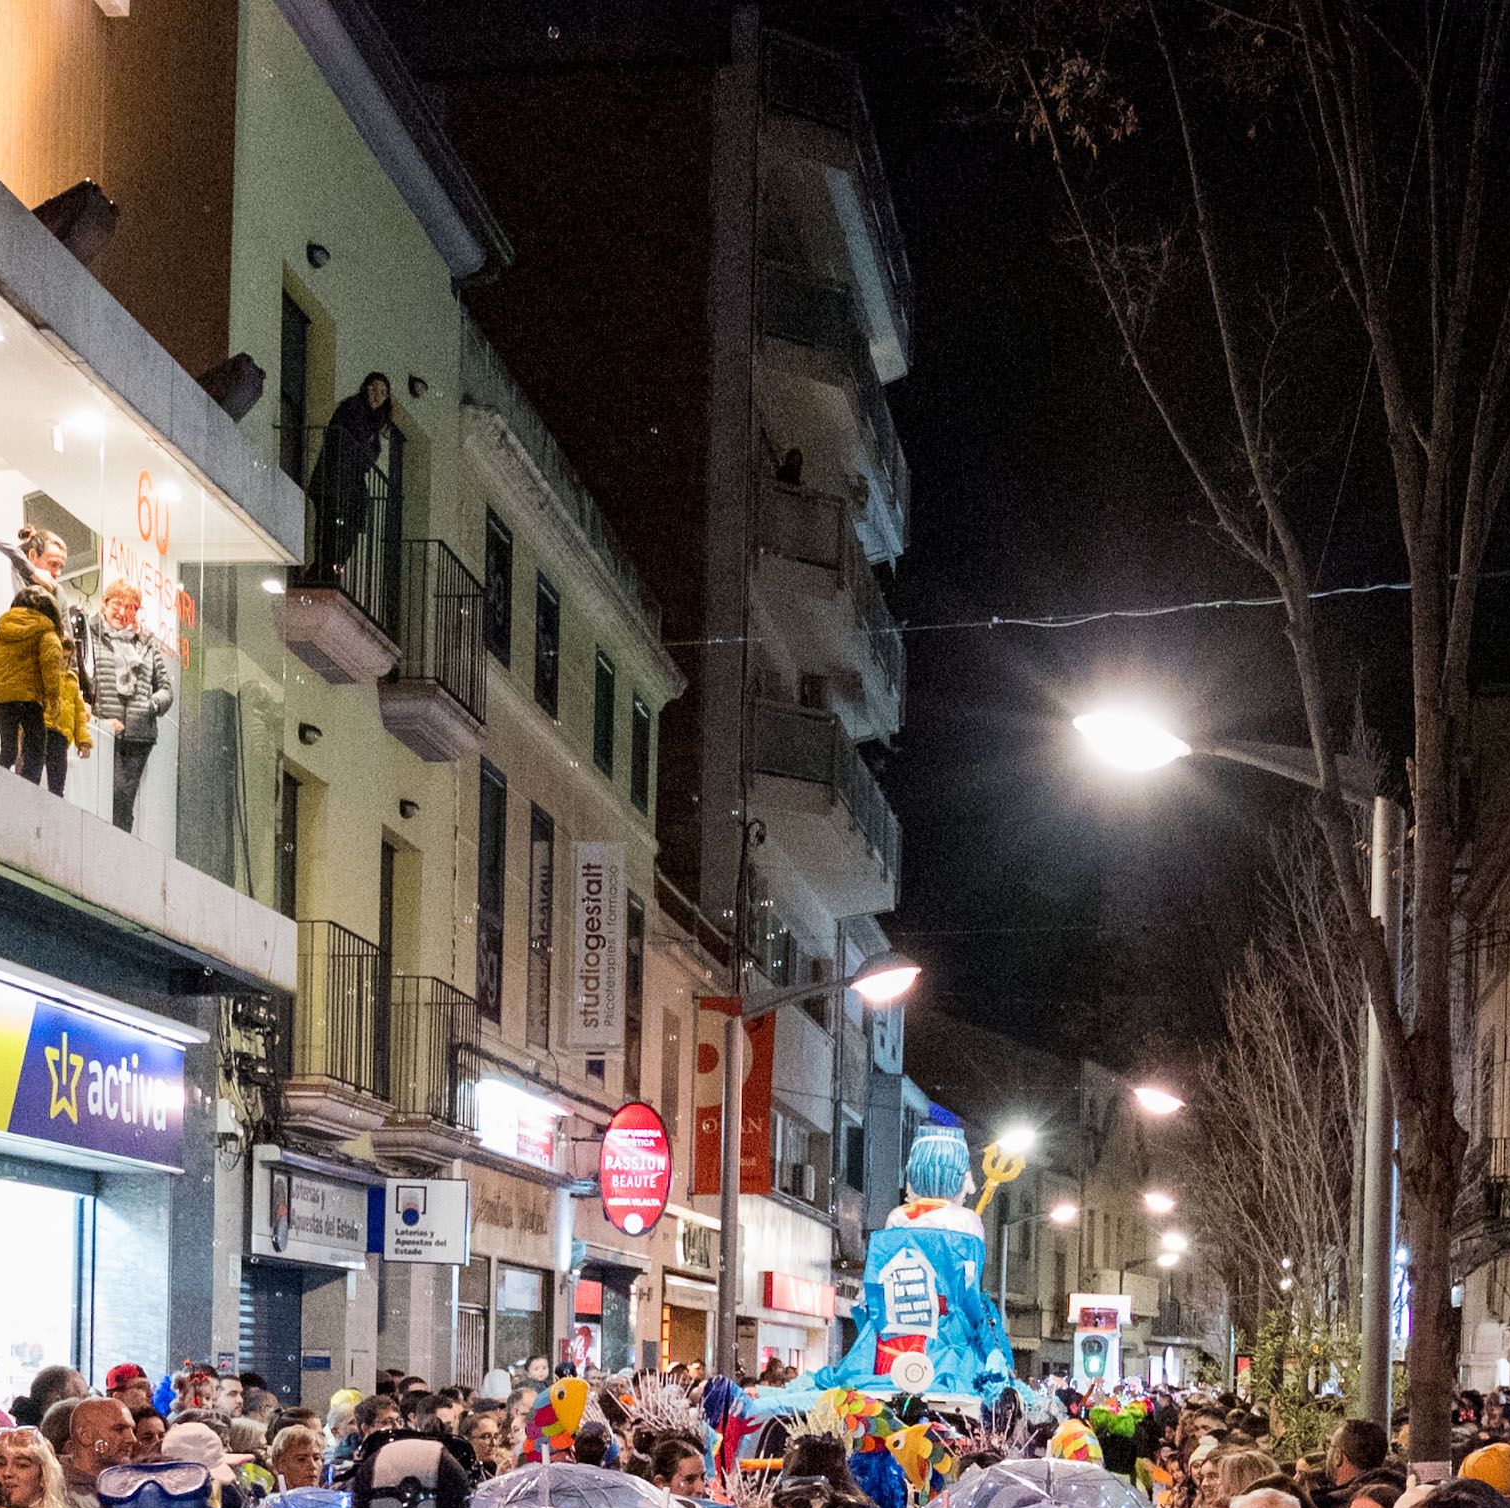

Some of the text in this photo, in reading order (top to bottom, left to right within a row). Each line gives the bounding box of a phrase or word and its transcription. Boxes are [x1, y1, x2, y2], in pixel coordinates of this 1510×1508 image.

[579, 862, 606, 1029] studiogestalt
[87, 1052, 167, 1132] activa
[604, 1155, 666, 1171] PASSION
